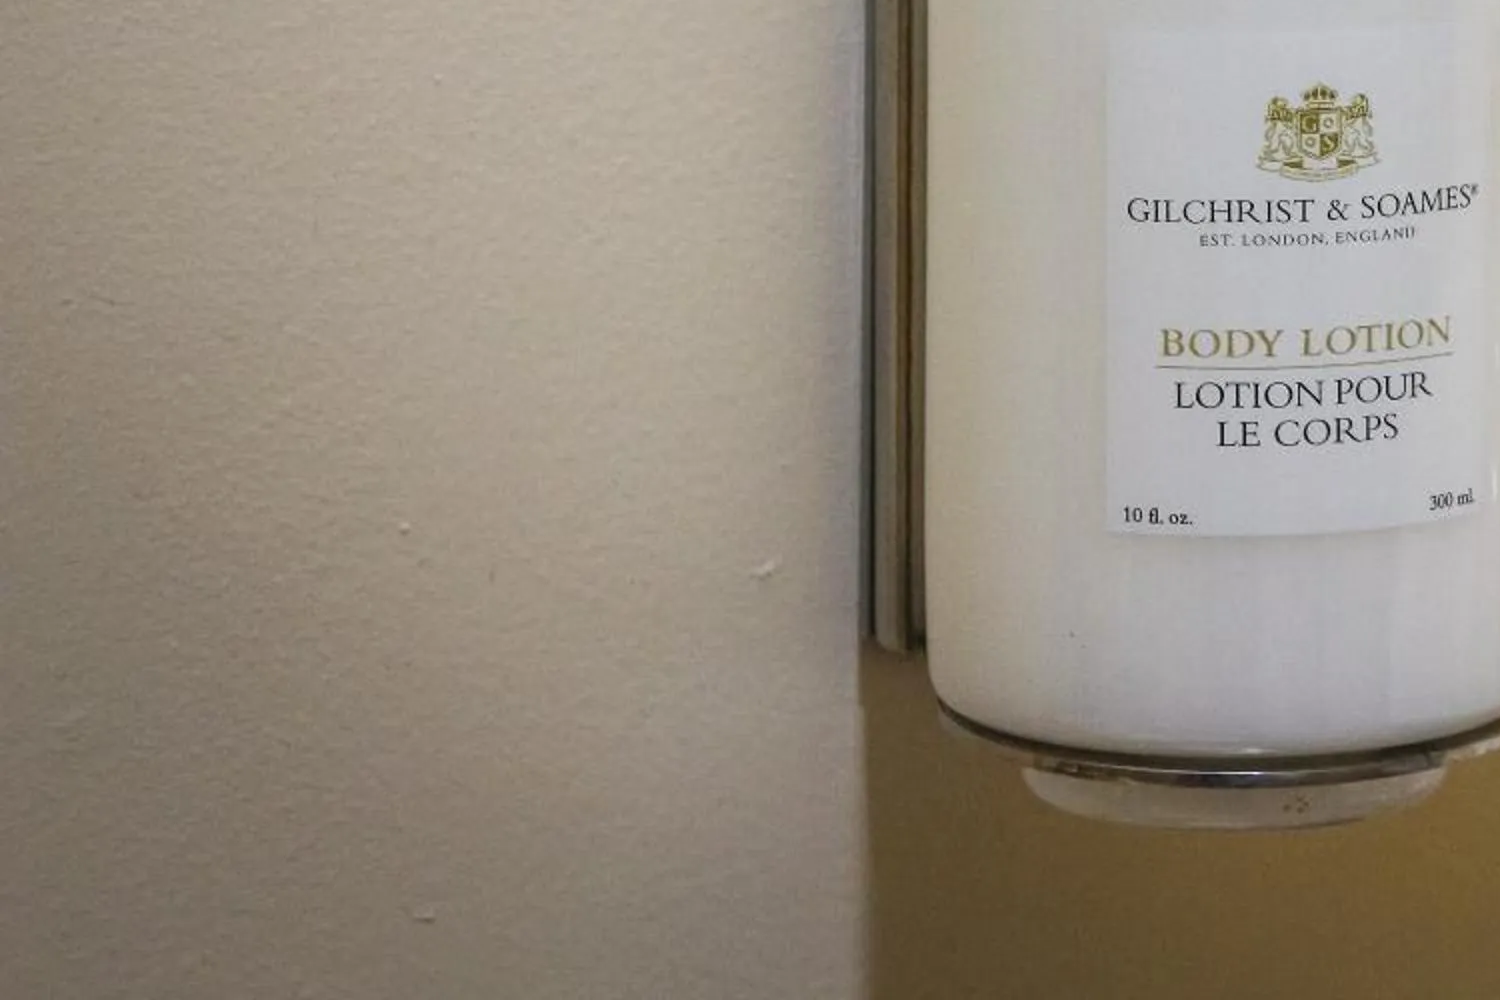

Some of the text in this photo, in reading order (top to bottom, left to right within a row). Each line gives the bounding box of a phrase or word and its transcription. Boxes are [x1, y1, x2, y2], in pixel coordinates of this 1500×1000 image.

[1126, 196, 1314, 225] GILCHRIST
[1326, 199, 1353, 222] &
[1335, 226, 1416, 246] ENGLAND
[1160, 315, 1454, 359] BODY LOTION
[1173, 370, 1434, 410] LOTION POUR
[1216, 412, 1401, 448] LE CORPS
[1428, 490, 1454, 511] 300
[1123, 506, 1143, 524] 10
[1168, 511, 1195, 526] oz.
